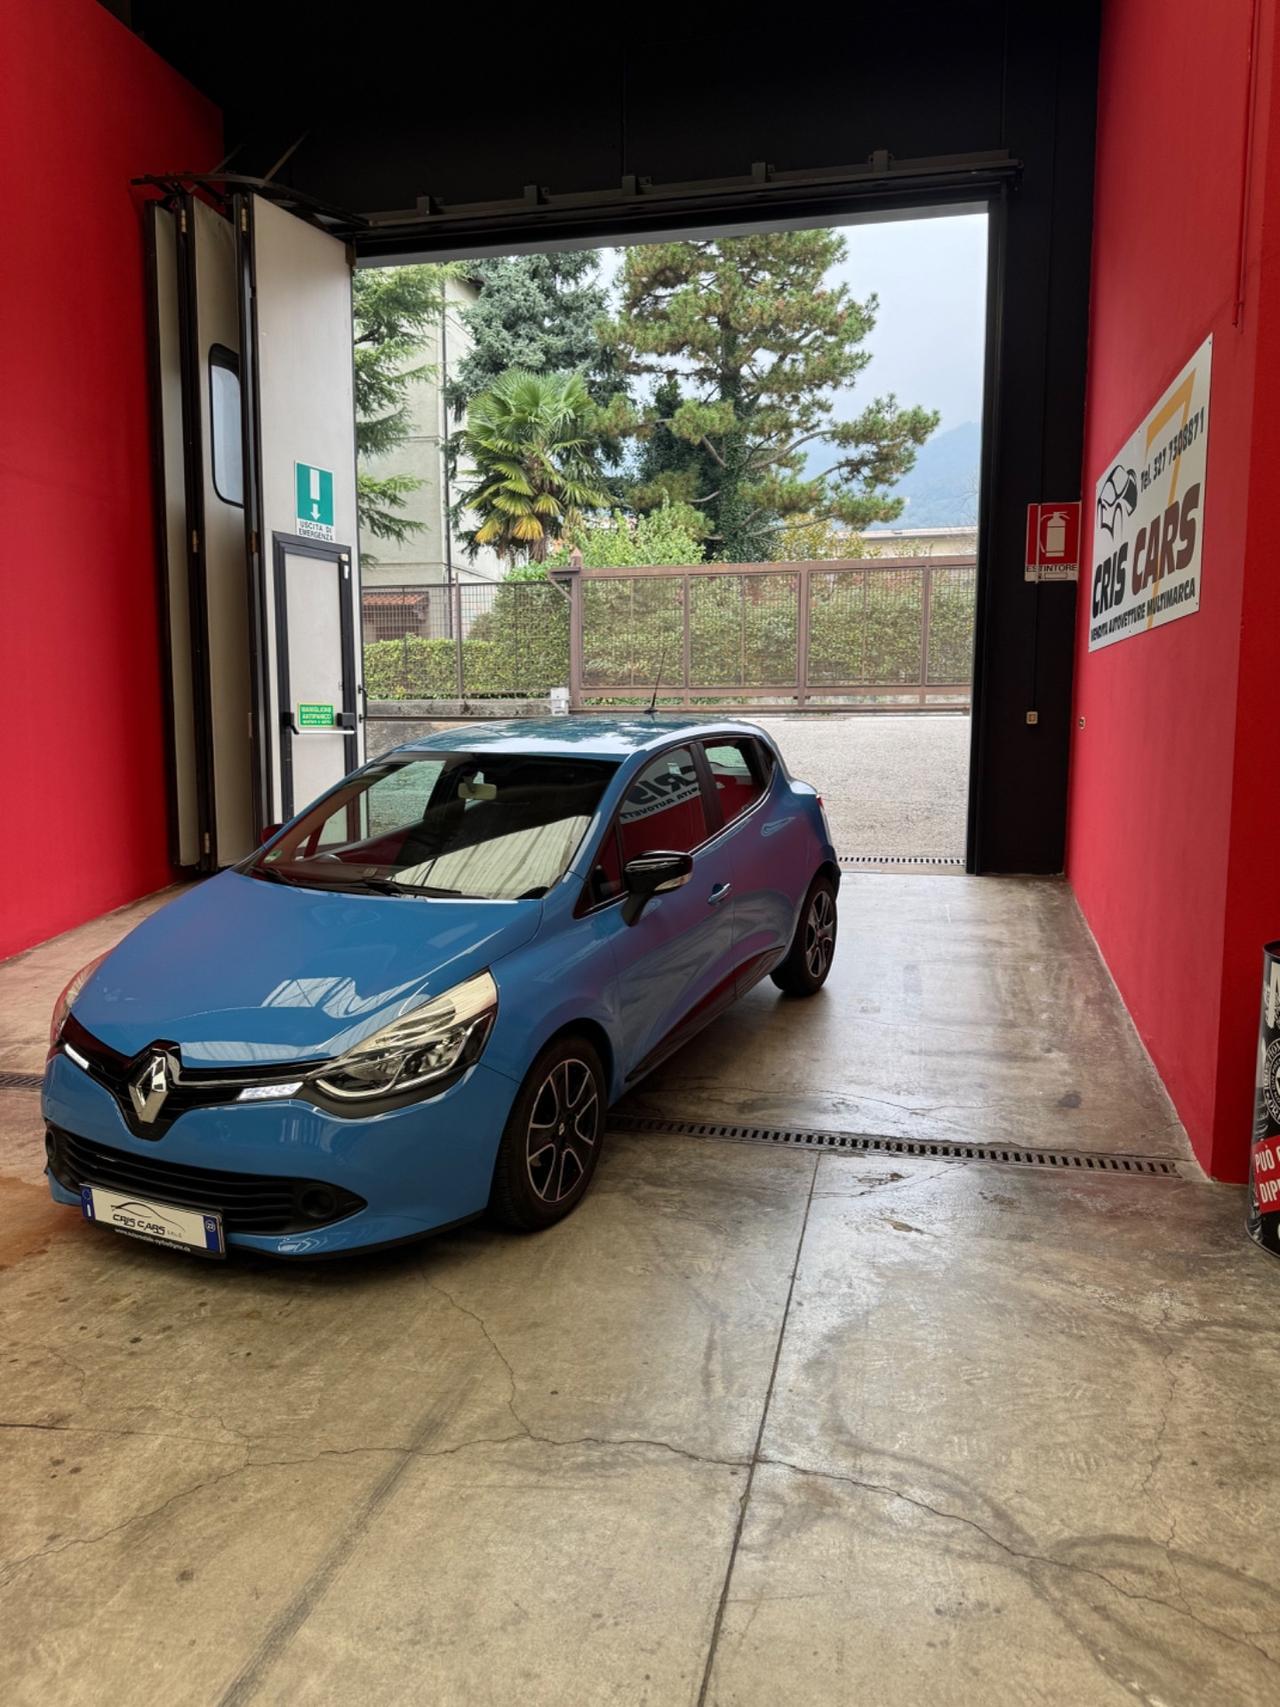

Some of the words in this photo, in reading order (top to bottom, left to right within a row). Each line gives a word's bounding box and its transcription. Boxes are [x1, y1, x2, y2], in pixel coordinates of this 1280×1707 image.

[1153, 447, 1167, 480] 327
[298, 528, 333, 541] EMERGENZA
[300, 520, 323, 531] USCITA
[1092, 541, 1129, 619] CRIS
[1132, 482, 1201, 596] CARS
[1026, 563, 1078, 573] ESTINTORE
[1109, 602, 1146, 633] AUTOVETTURE
[1146, 577, 1196, 617] MULTIMARCA
[1255, 1144, 1275, 1174] PUÒ
[112, 1213, 136, 1228] CRIS
[137, 1220, 166, 1236] CARS
